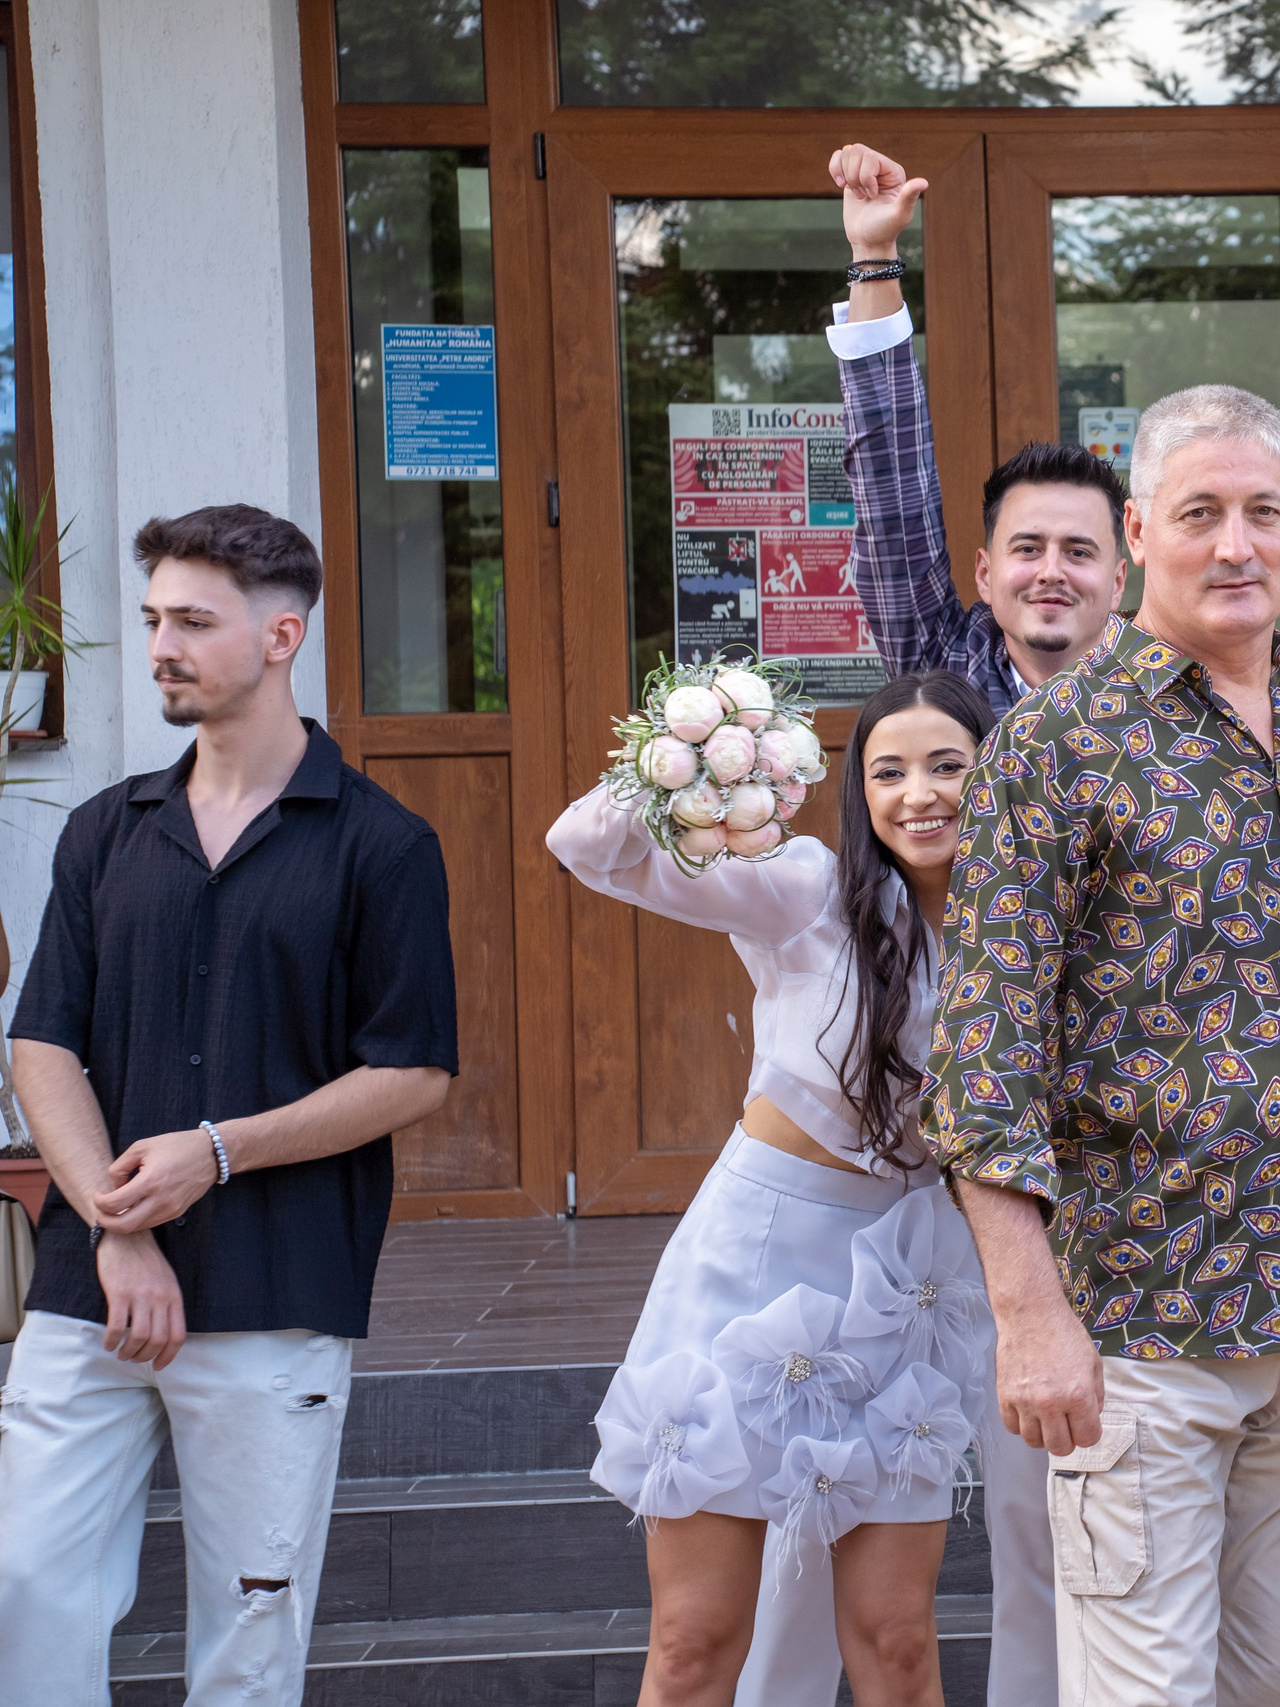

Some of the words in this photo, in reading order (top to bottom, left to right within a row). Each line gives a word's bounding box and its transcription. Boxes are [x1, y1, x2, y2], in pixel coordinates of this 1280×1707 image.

[448, 338, 491, 348] ROMÂNIA
[385, 354, 438, 362] UNIVERSITATEA
[675, 442, 708, 451] REGULI
[710, 442, 722, 451] DE
[724, 442, 802, 451] COMPORTAMENT
[692, 451, 703, 460] ÎN
[705, 451, 724, 460] CAZ
[726, 451, 737, 460] DE
[739, 451, 785, 460] INCENDIU
[810, 456, 845, 464] EVACUA
[719, 461, 729, 470] ÎN
[731, 461, 760, 471] SPAȚII
[406, 467, 432, 475] 0721
[436, 467, 455, 475] 718
[459, 467, 478, 475] 748
[701, 471, 715, 480] CU
[716, 470, 778, 480] AGLOMERĂRI
[709, 480, 720, 489] DE
[722, 480, 771, 489] PERSOANE
[770, 498, 803, 506] CALMUL
[677, 533, 690, 541] NU
[762, 530, 798, 540] PĂRĂSIȚI
[799, 531, 840, 539] ORDONAT
[677, 541, 716, 552] UTILIZAȚI
[677, 550, 704, 558] LIFTUL
[677, 558, 709, 566] PENTRU
[678, 567, 719, 575] EVACUARE
[773, 602, 795, 611] DACĂ
[797, 602, 810, 611] NU
[811, 601, 823, 611] VĂ
[824, 602, 852, 612] PUTEȚI
[853, 602, 865, 611] EV
[810, 658, 855, 667] INCENDIUL
[856, 658, 867, 666] LA
